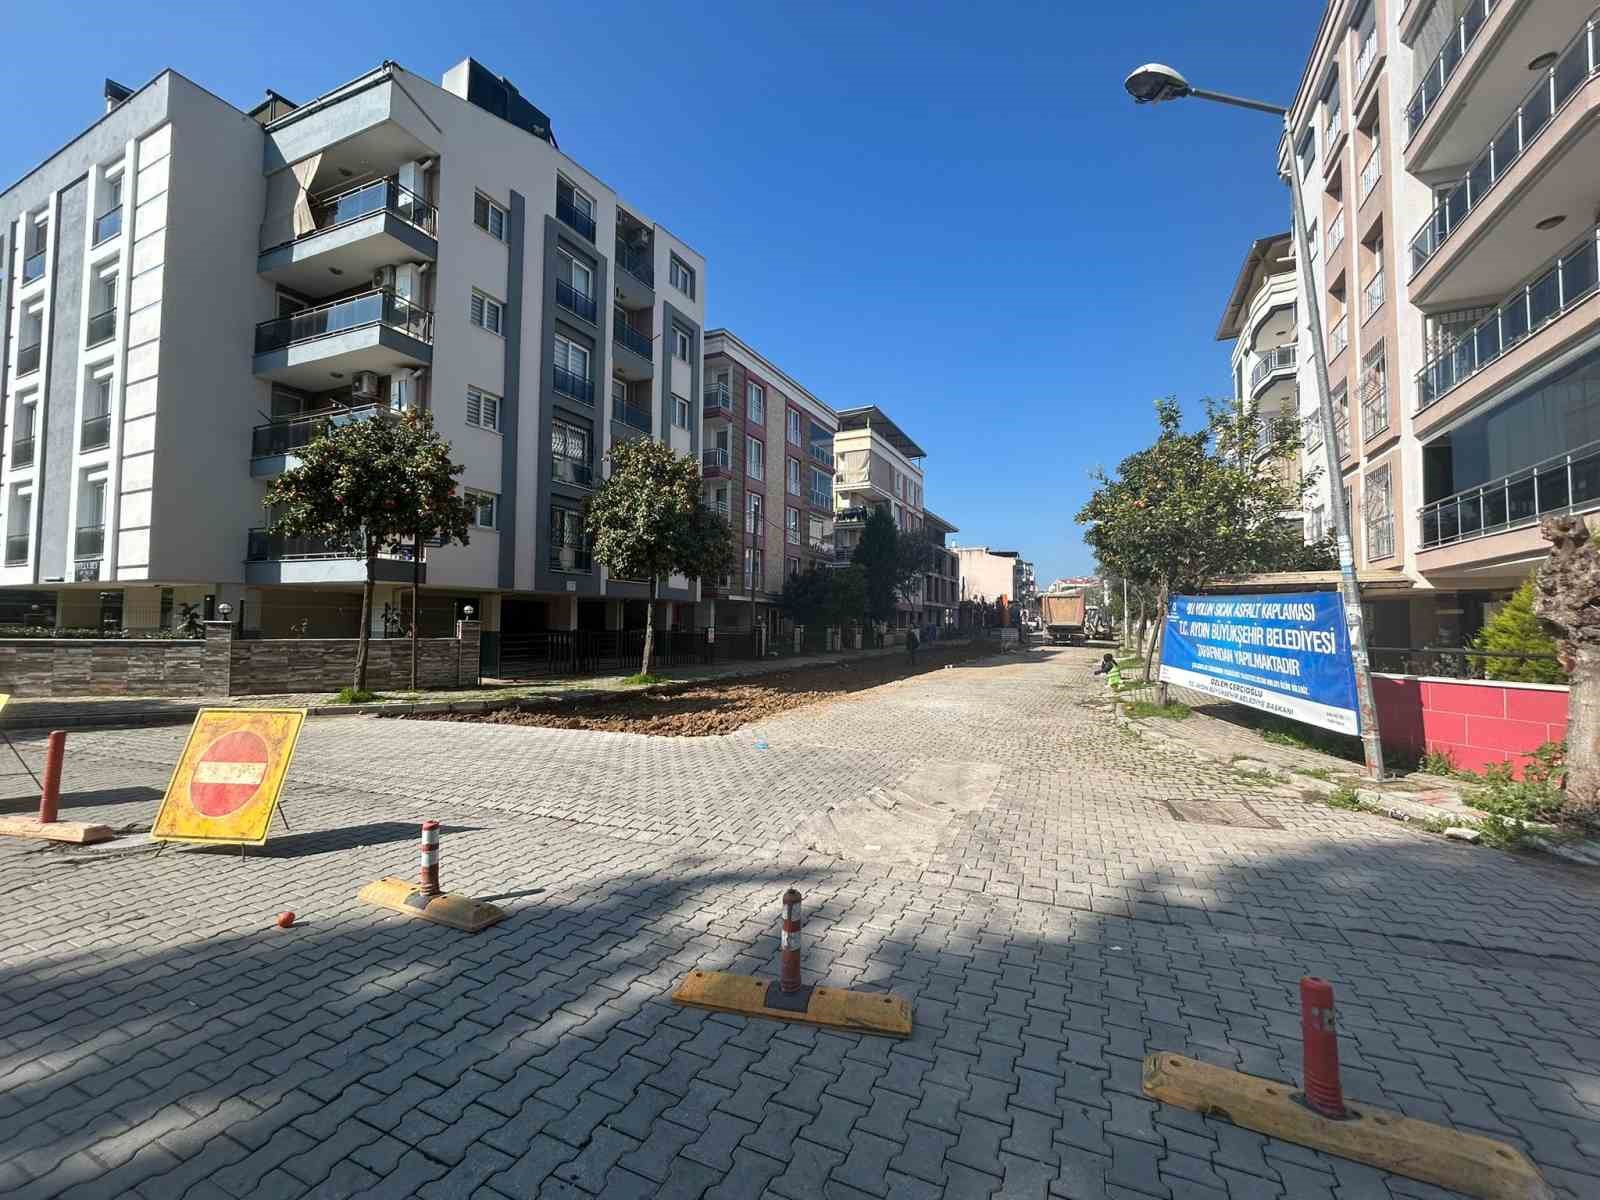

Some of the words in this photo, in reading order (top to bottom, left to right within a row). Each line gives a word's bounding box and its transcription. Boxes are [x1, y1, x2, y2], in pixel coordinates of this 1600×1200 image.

[1233, 603, 1261, 619] ASFALT
[1261, 603, 1315, 622] KAPLAMASI
[1190, 621, 1210, 639] AYDIN
[1211, 619, 1264, 648] BÜYÜKŞEHİR
[1266, 625, 1336, 655] BELEDİYESİ
[1233, 650, 1301, 677] YAPILMAKTADIR
